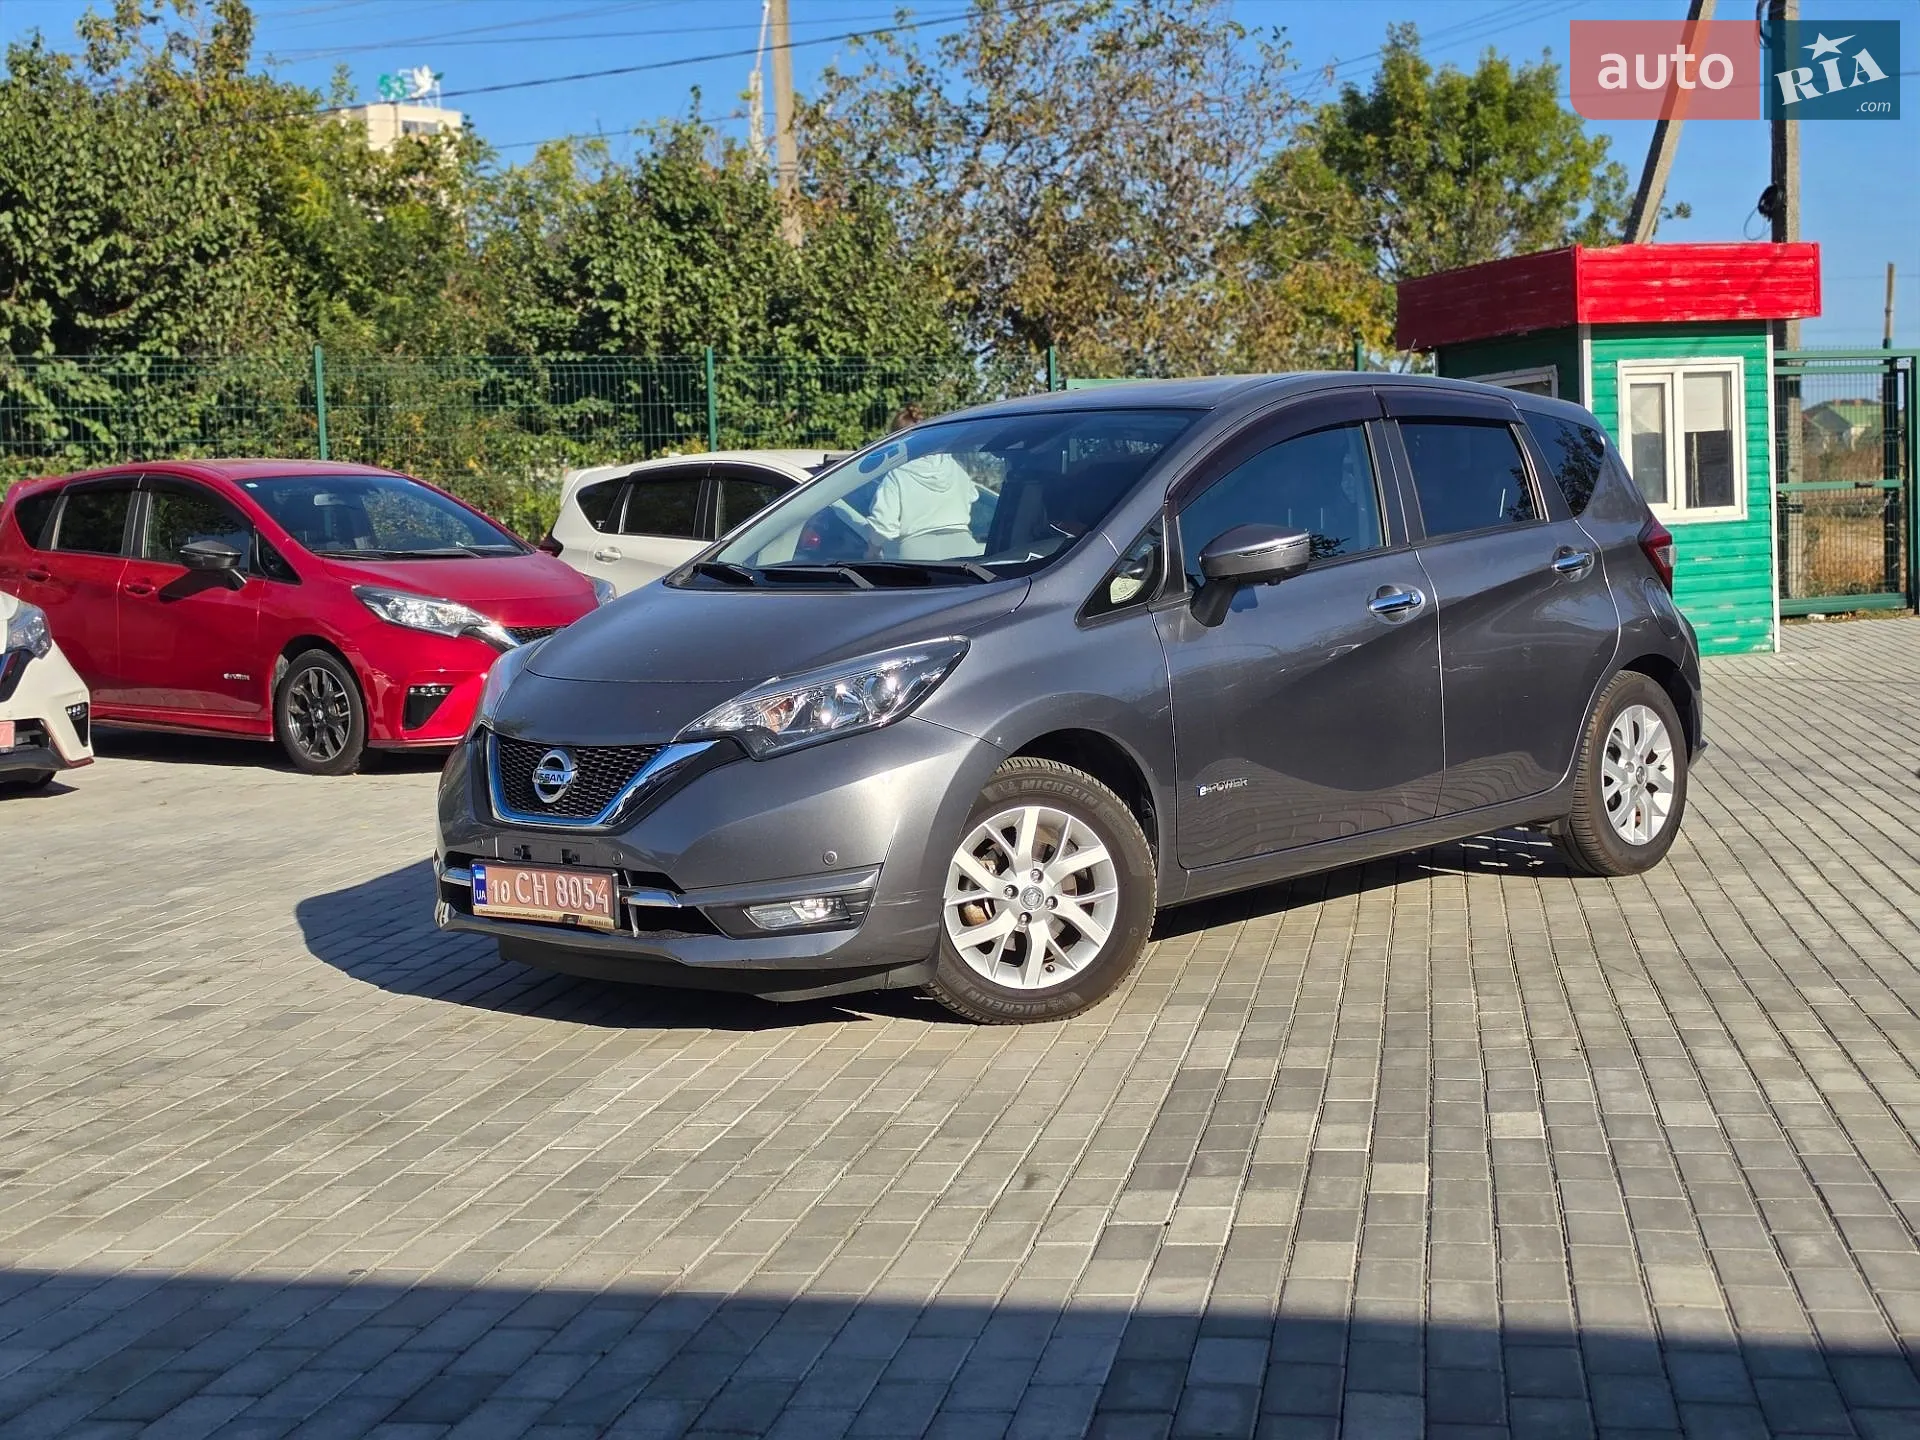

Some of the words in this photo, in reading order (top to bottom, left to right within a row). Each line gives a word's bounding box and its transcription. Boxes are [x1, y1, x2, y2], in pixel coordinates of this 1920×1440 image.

[534, 772, 565, 783] ISSAN
[1020, 779, 1098, 806] MICHELIN
[475, 890, 487, 900] UA
[490, 879, 511, 903] 10
[515, 871, 549, 906] CH
[555, 874, 609, 913] 8054
